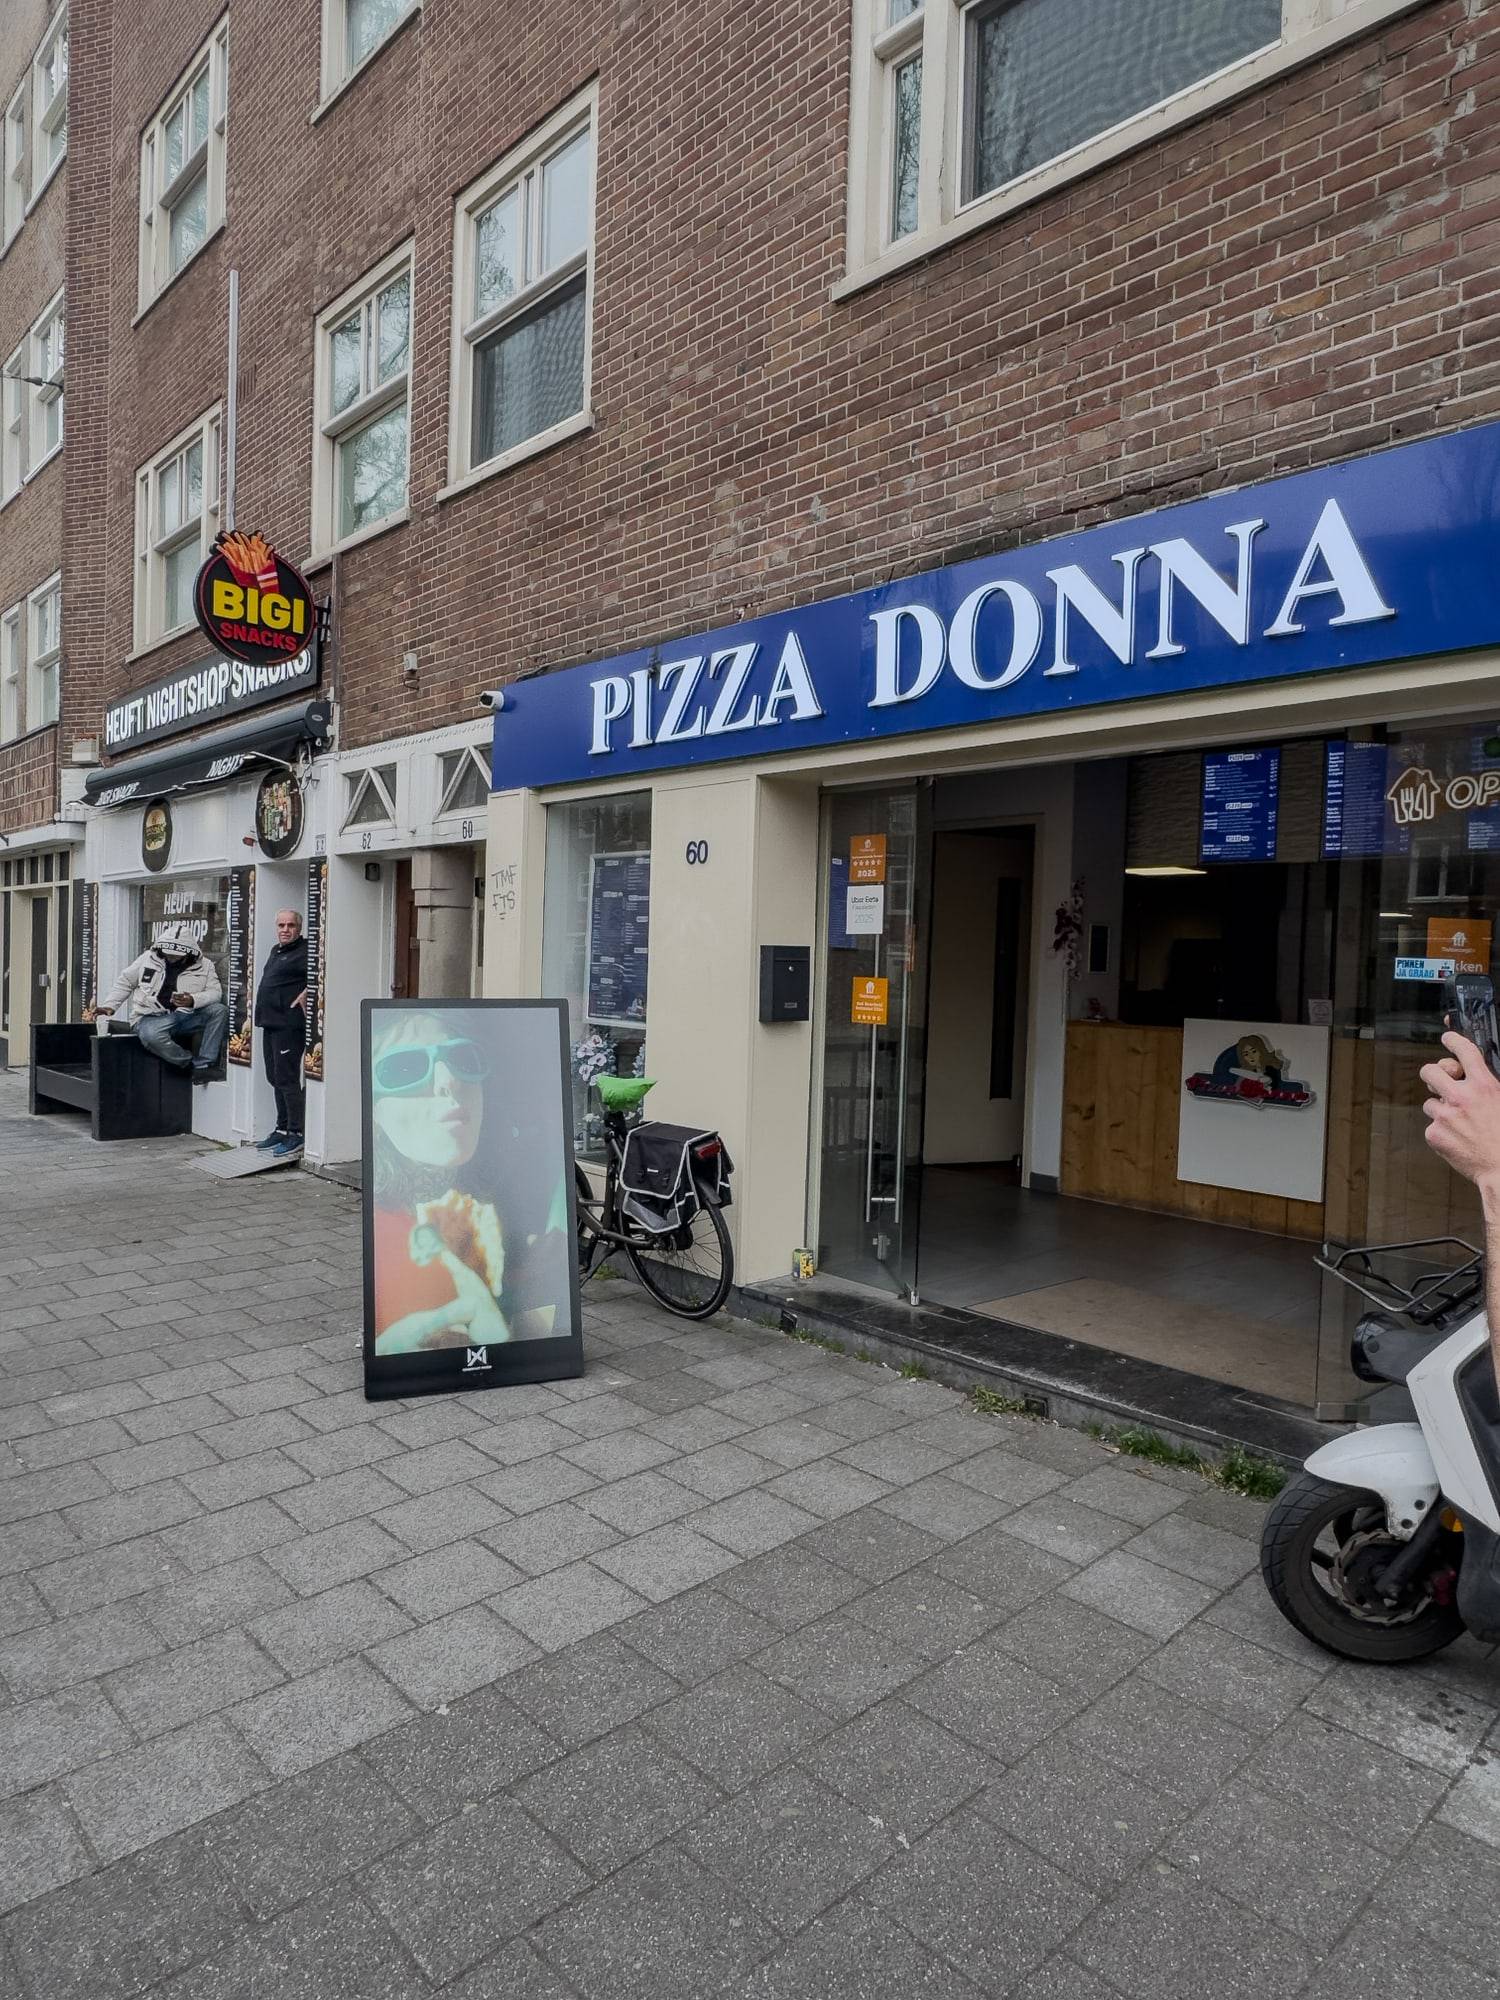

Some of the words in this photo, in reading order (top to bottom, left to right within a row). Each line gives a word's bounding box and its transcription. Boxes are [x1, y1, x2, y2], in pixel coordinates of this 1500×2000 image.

[213, 579, 304, 634] BIGI
[220, 622, 297, 652] SNACKS
[588, 631, 824, 755] PIZZA
[867, 498, 1396, 707] DONNA
[106, 698, 145, 745] HEUFT
[147, 662, 231, 729] NIGHTSHOP
[362, 832, 372, 849] 62
[463, 820, 473, 839] 60
[686, 840, 708, 865] 60
[163, 892, 194, 915] HEUFT
[151, 919, 209, 943] NIGHOP
[1397, 960, 1425, 969] PINNEN
